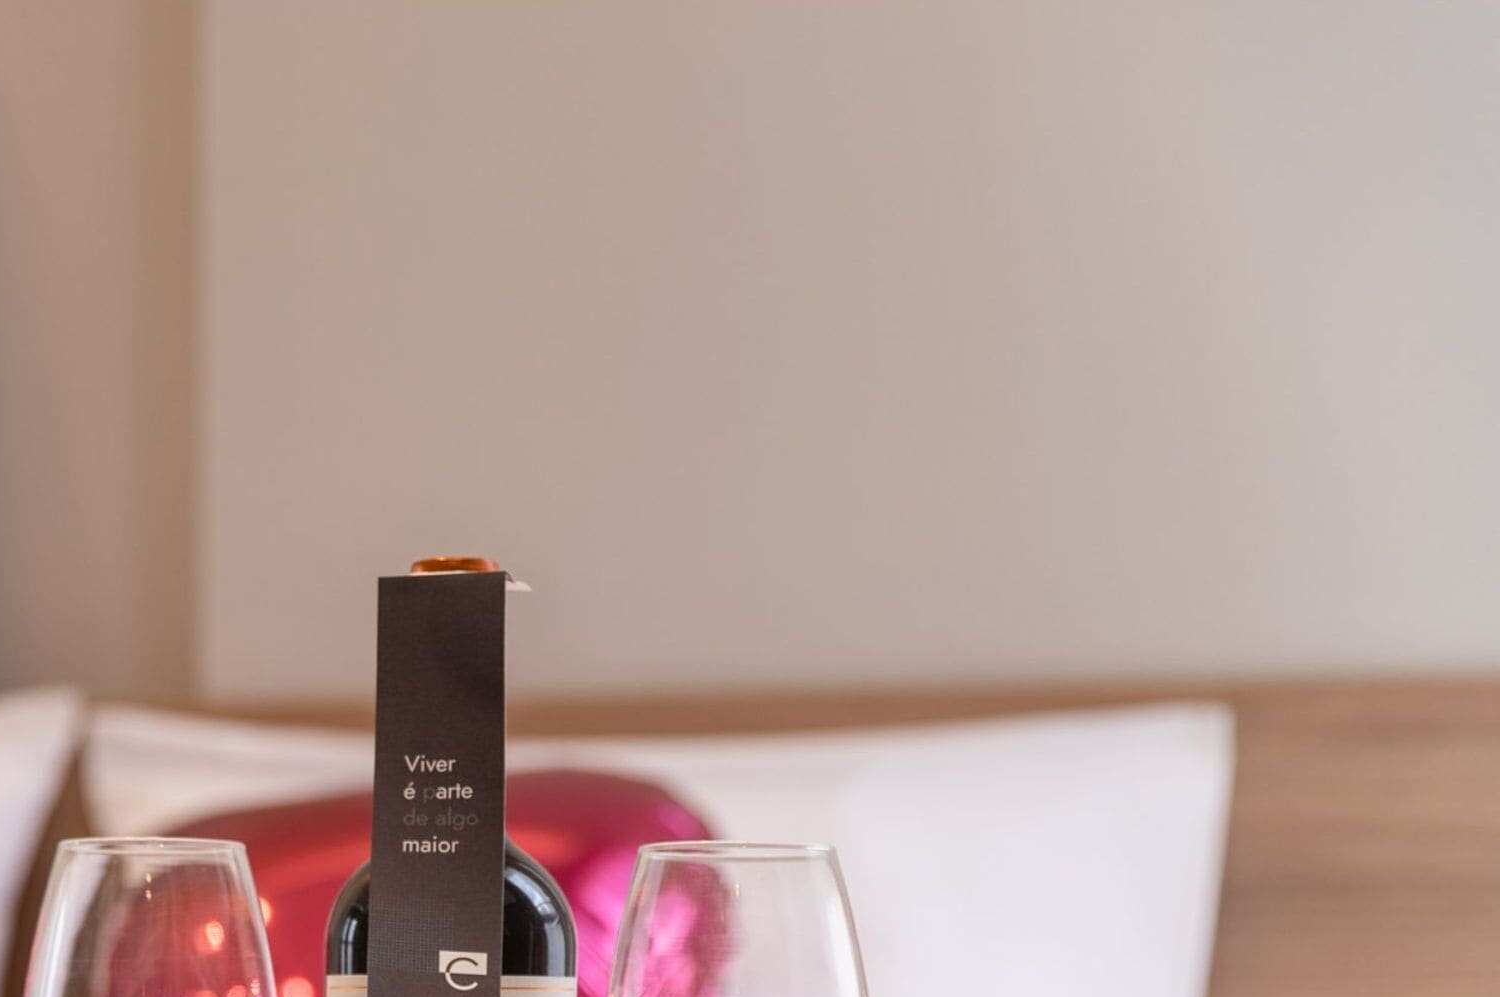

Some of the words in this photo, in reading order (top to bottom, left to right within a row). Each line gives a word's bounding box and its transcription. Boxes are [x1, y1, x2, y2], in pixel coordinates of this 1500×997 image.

[404, 755, 457, 773] Viver
[403, 782, 417, 800] é
[403, 809, 429, 827] de
[435, 809, 479, 831] algo
[402, 836, 460, 853] maior
